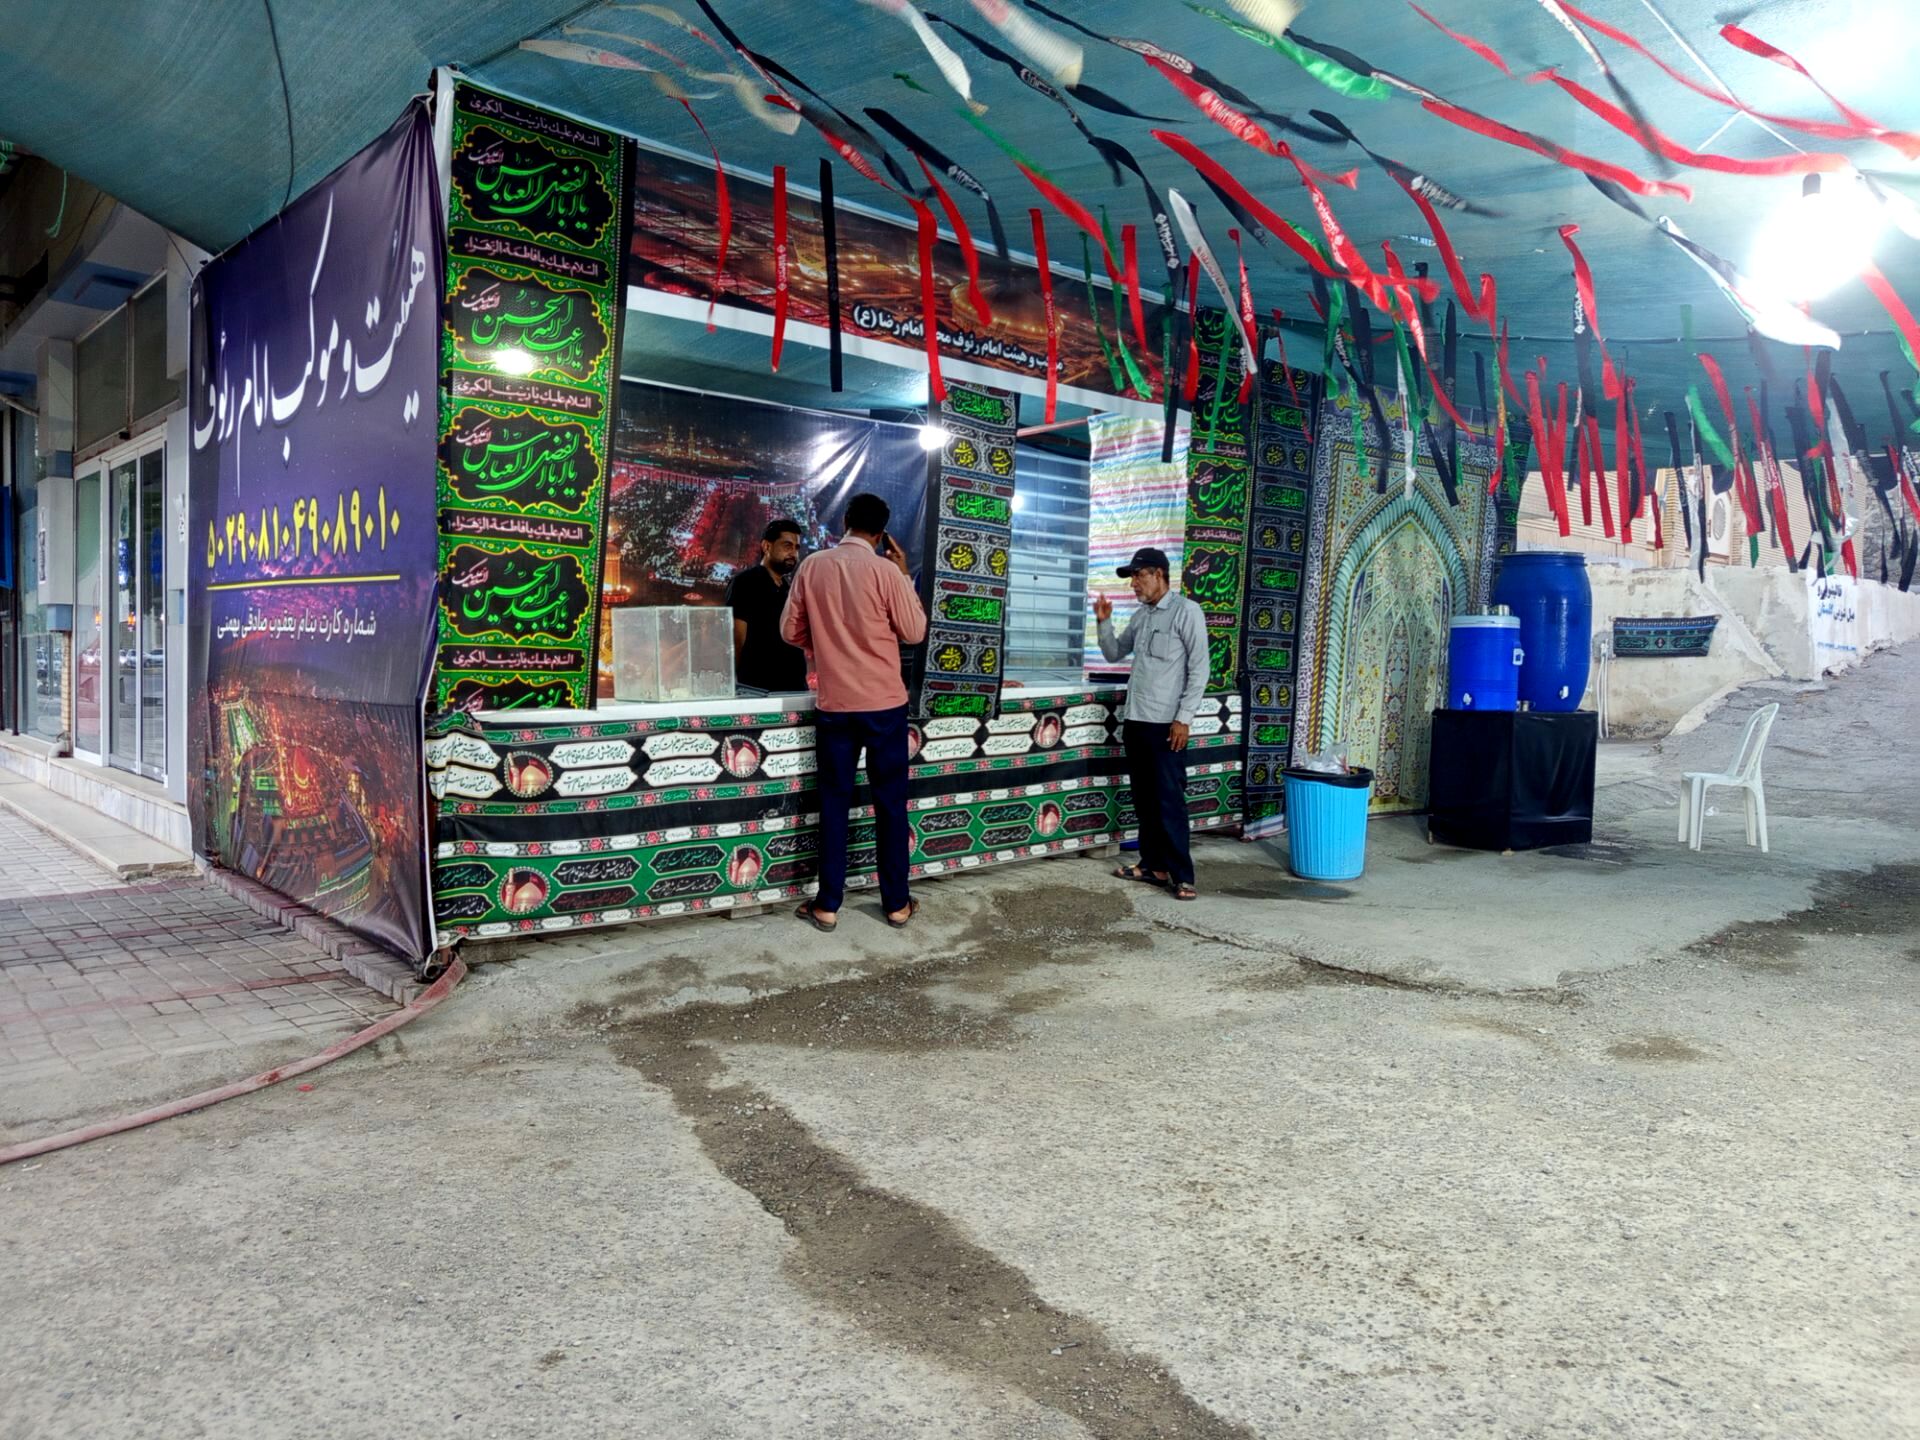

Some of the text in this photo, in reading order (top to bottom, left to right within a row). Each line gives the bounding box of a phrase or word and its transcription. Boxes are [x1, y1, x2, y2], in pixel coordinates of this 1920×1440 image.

[272, 191, 339, 461] موکب
[878, 310, 900, 335] رضا
[901, 319, 924, 338] امام
[980, 341, 1003, 359] امام
[1028, 358, 1036, 369] و
[1036, 358, 1063, 373] مب
[340, 339, 352, 399] و
[236, 344, 268, 498] امام
[297, 608, 318, 640] بنام
[319, 607, 343, 642] کارت
[343, 607, 377, 643] شماره
